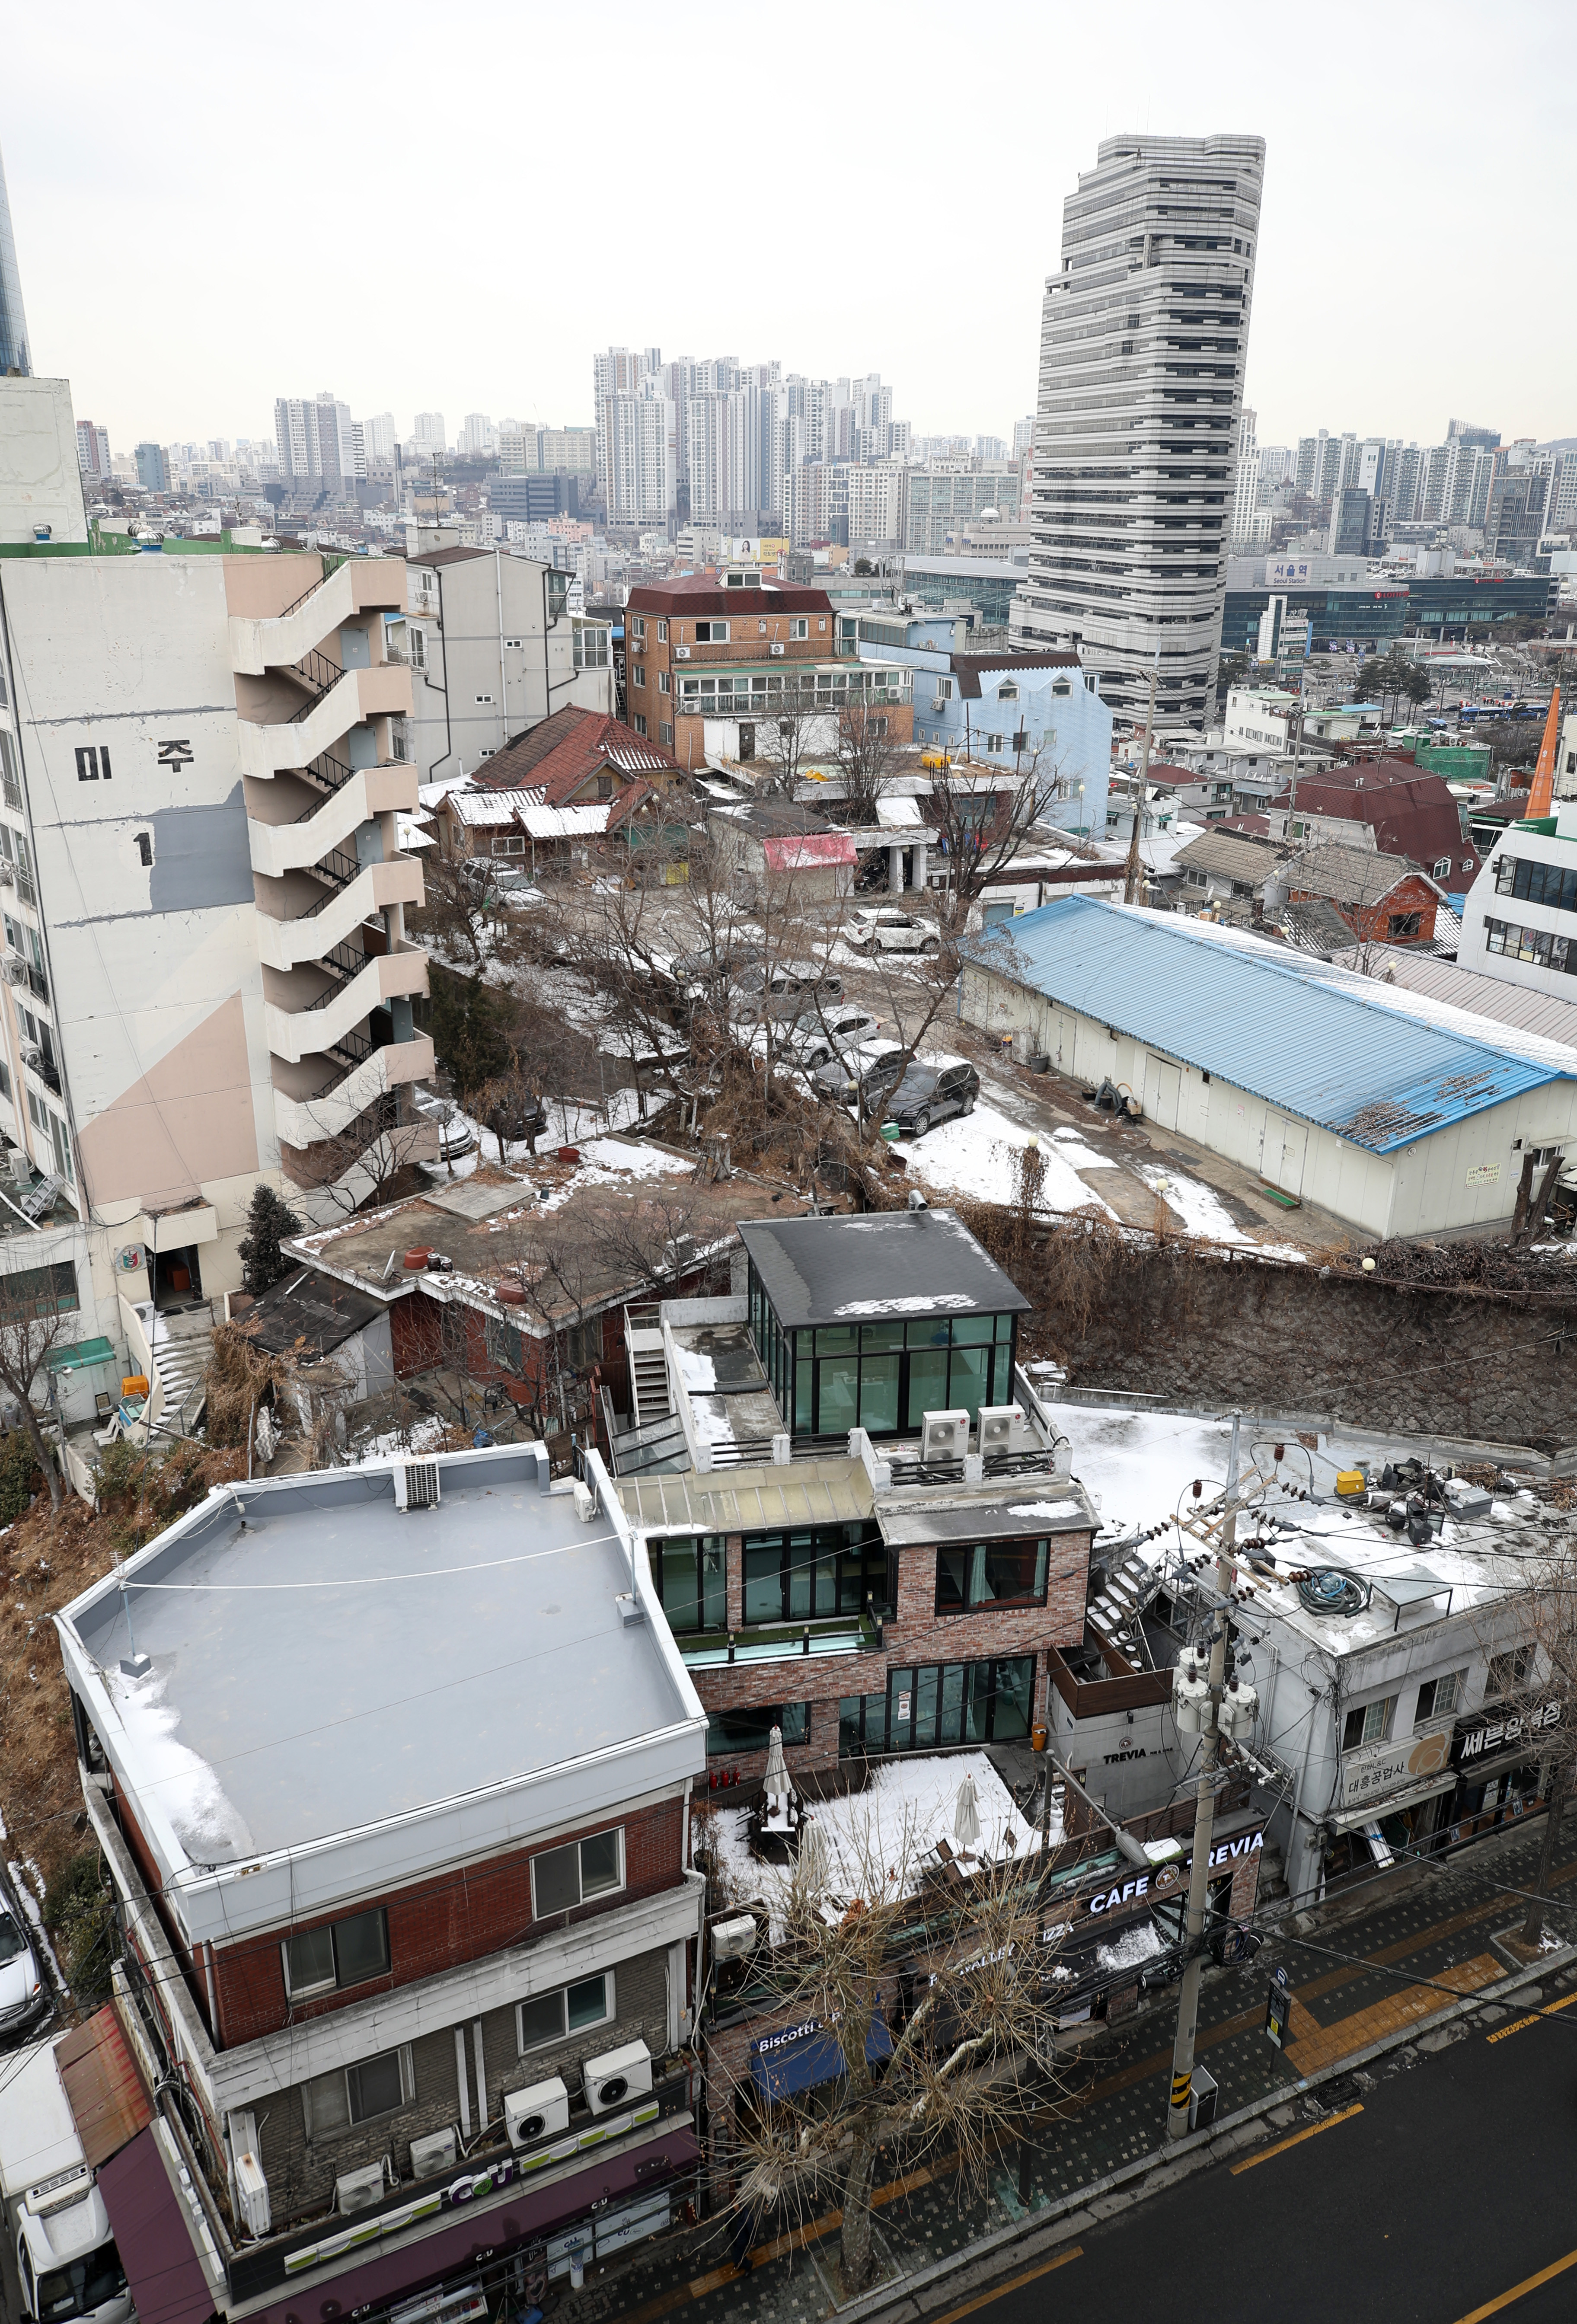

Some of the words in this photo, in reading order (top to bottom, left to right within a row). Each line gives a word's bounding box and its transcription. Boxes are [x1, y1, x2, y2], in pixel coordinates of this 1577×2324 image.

[1275, 565, 1307, 576] 서울역
[133, 832, 153, 867] 1
[1103, 1748, 1146, 1764] TREVIA
[1348, 1761, 1405, 1793] 대흥공업사
[1090, 1875, 1149, 1913] CAFE
[1043, 1921, 1074, 1943] IZZA
[760, 2021, 814, 2053] Biscotti
[591, 2197, 608, 2210] CU
[476, 2249, 493, 2261] CU
[351, 2304, 370, 2318] CU
